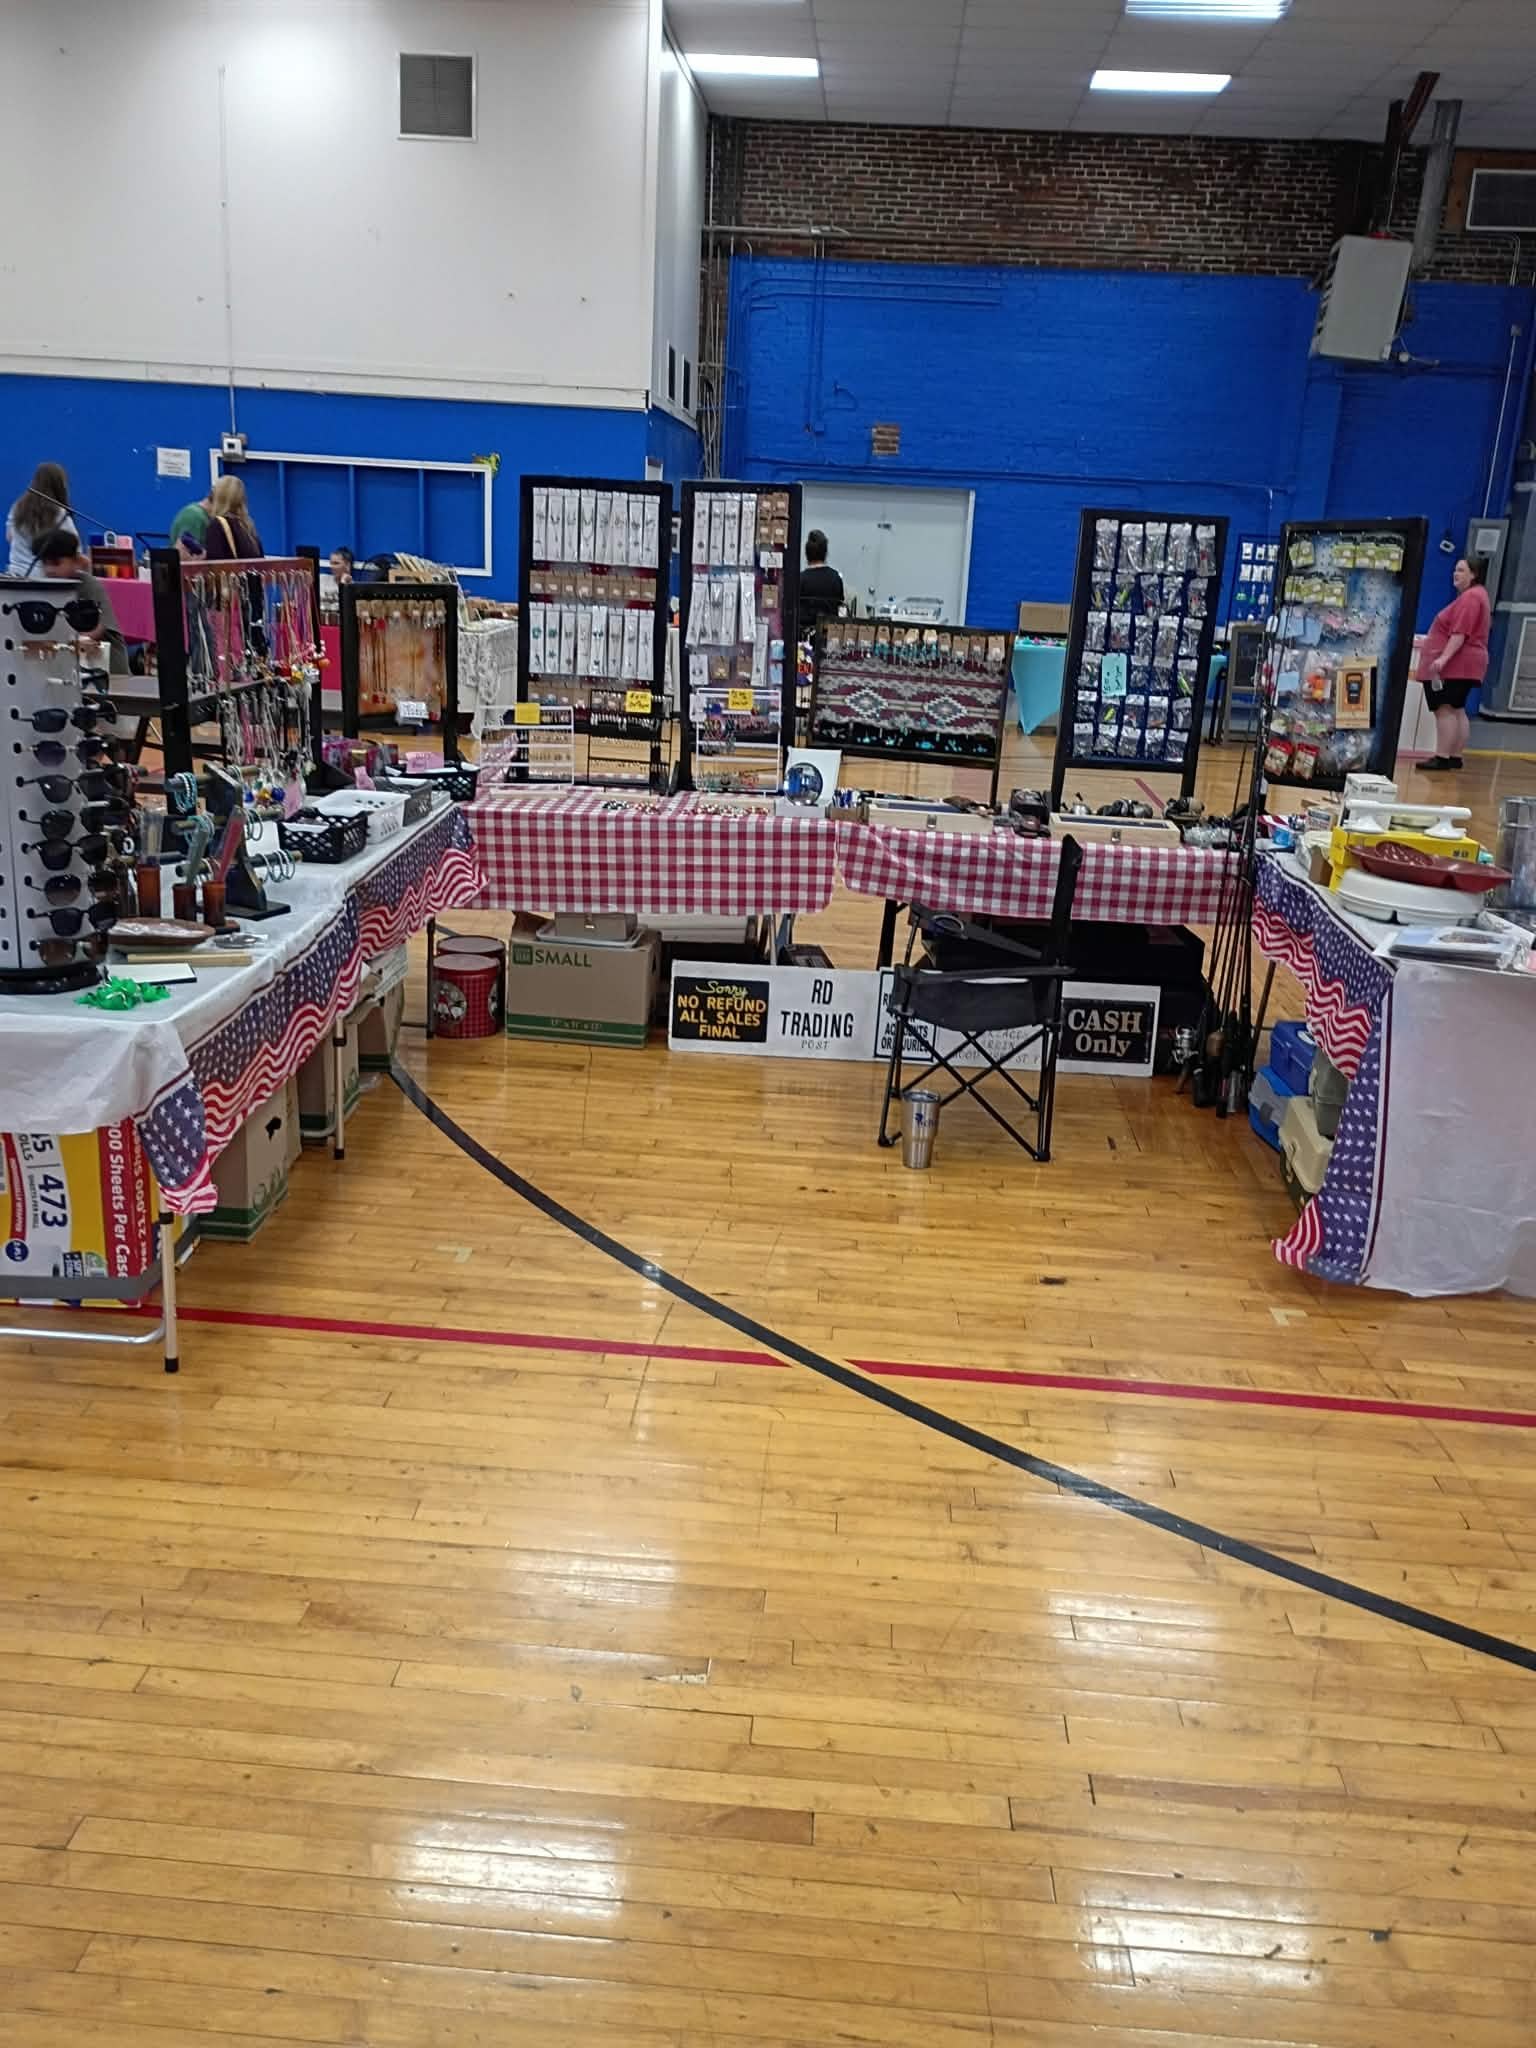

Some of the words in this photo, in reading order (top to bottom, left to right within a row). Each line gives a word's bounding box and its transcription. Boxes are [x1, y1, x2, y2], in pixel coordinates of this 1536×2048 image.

[535, 949, 592, 968] SMALL
[696, 981, 748, 998] Sorry
[811, 979, 833, 1005] RD
[677, 995, 699, 1009] NO
[706, 996, 766, 1013] REFUND
[679, 1010, 708, 1023] ALL
[716, 1011, 760, 1026] SALES
[781, 1010, 854, 1038] TRADING
[1067, 1009, 1143, 1033] CASH
[699, 1024, 741, 1039] FINAL
[801, 1040, 830, 1050] POST
[1075, 1033, 1132, 1057] Only
[18, 1133, 34, 1161] OLLS
[110, 1154, 124, 1210] Sheets
[38, 1174, 68, 1227] 473
[135, 1179, 147, 1238] 21,000
[113, 1214, 128, 1240] Per
